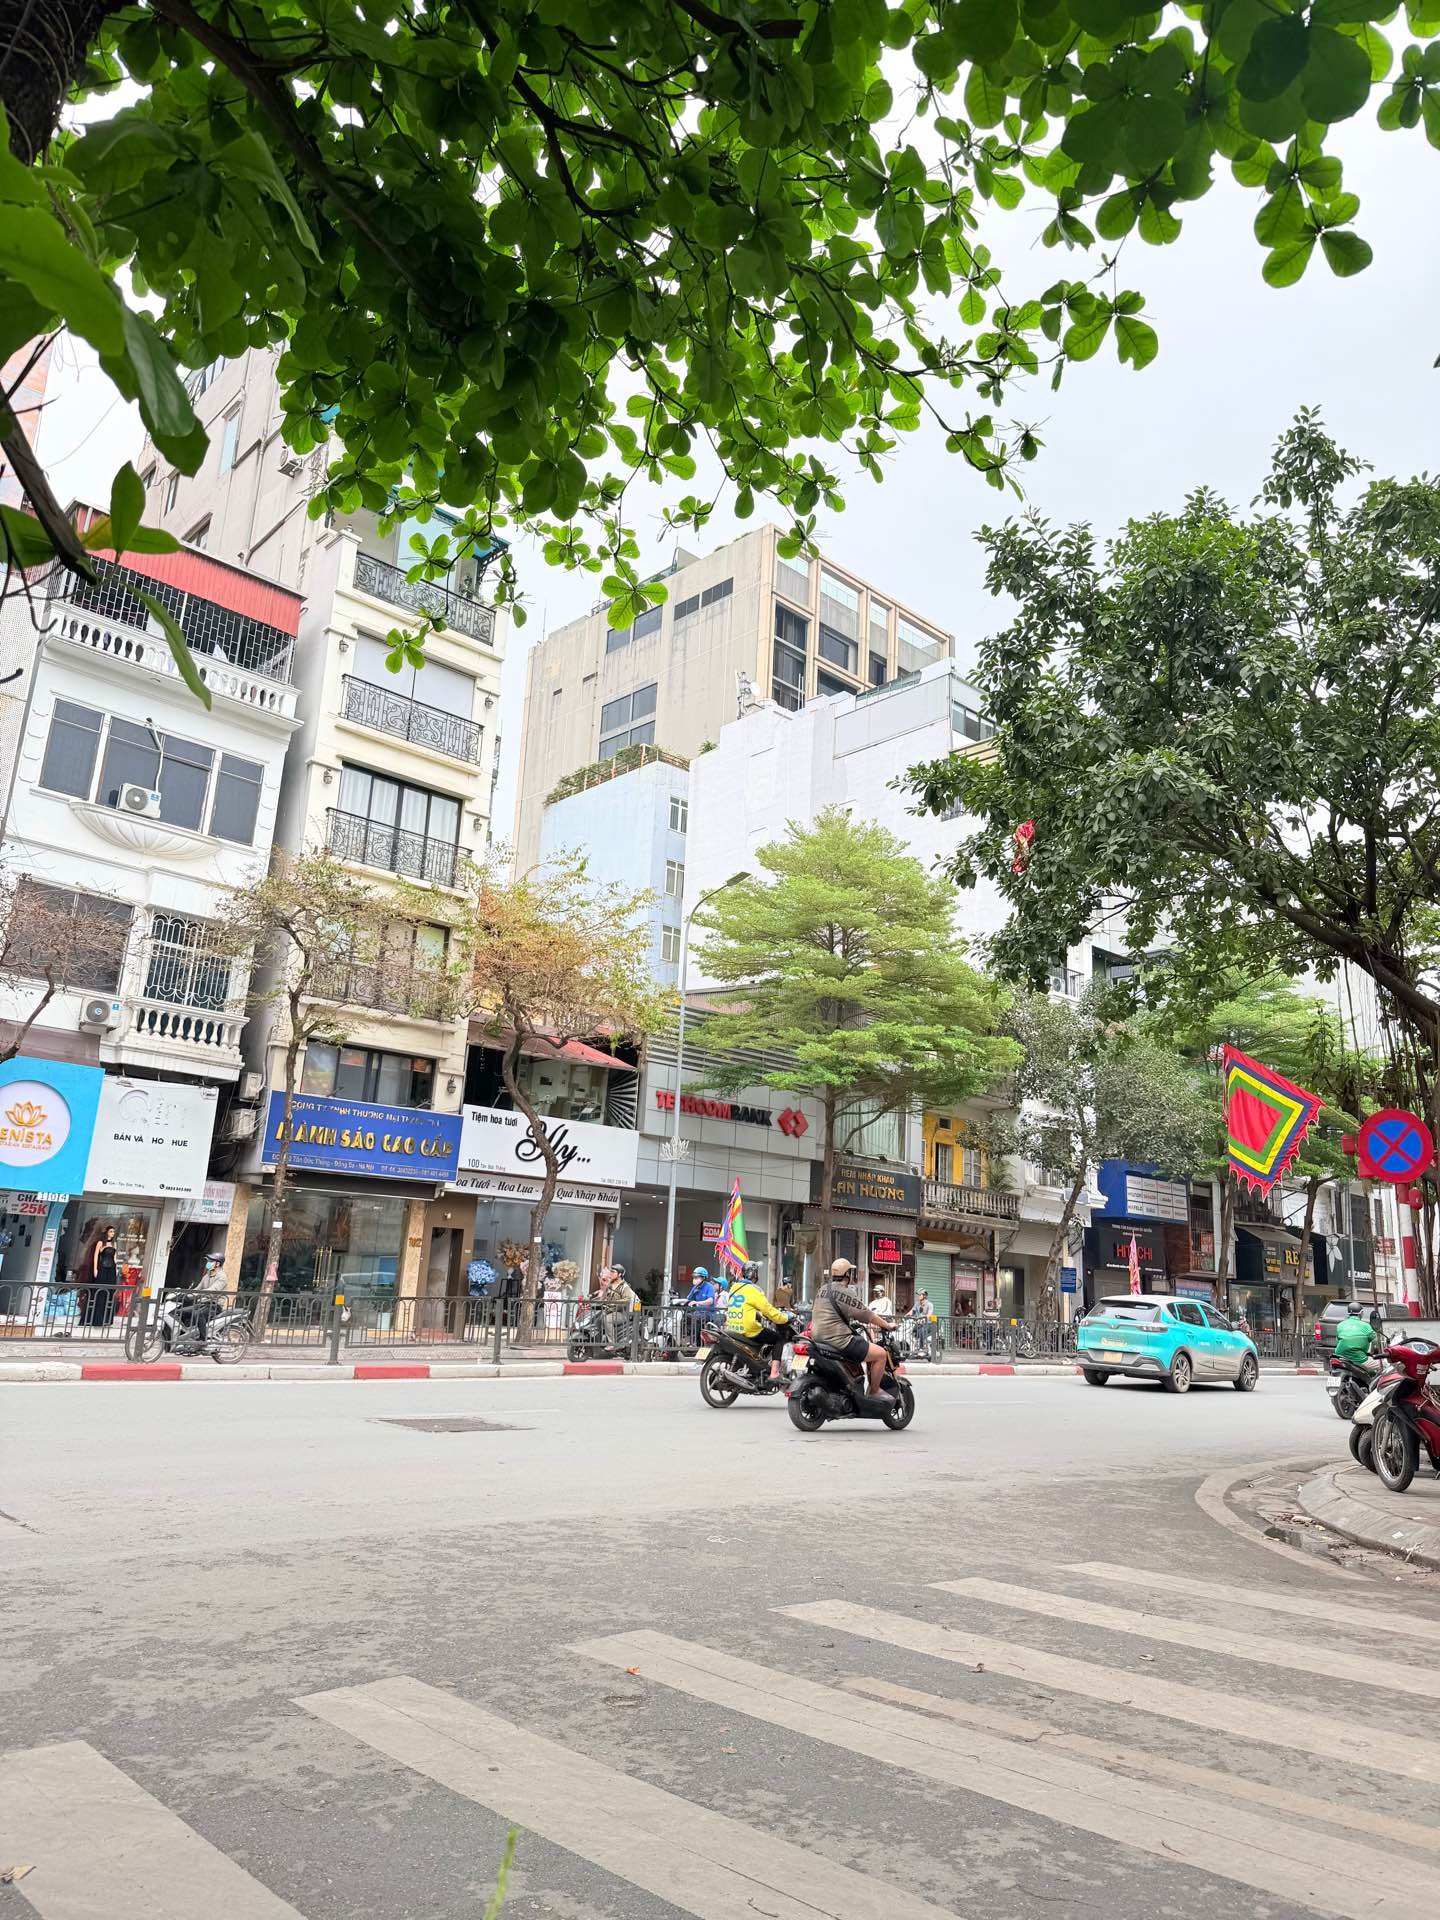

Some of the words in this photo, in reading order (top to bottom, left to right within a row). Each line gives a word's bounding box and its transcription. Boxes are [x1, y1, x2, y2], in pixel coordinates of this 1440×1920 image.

[655, 1090, 773, 1126] TEHCOMBANK
[472, 1111, 488, 1123] Tiệm
[490, 1114, 503, 1125] hoa
[505, 1116, 518, 1127] tươi
[340, 1126, 375, 1151] SÁO
[468, 1158, 480, 1168] 100
[497, 1181, 516, 1192] Hoa
[832, 1182, 856, 1195] AN
[20, 1203, 48, 1214] 25K
[1115, 1244, 1153, 1261] HITCHI
